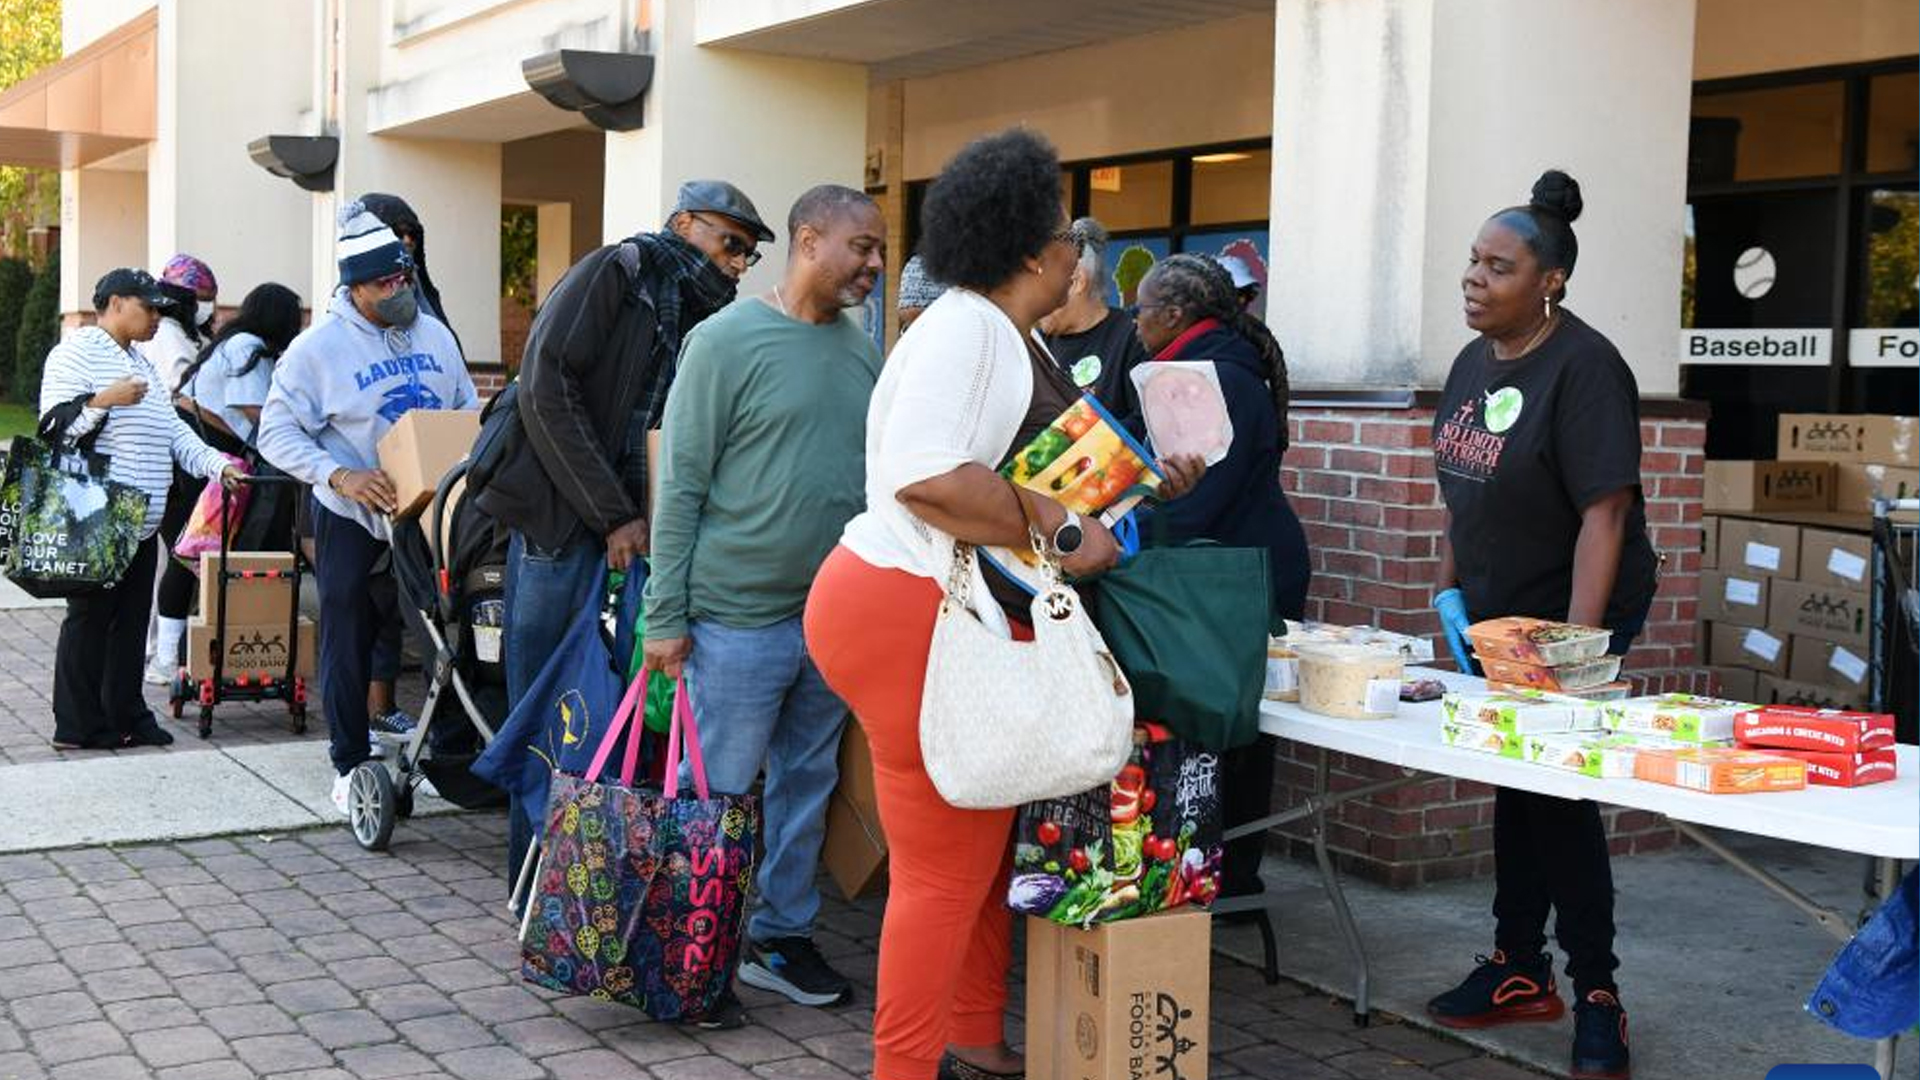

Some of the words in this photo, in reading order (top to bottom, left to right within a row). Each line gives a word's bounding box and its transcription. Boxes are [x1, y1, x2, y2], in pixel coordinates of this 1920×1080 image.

[1689, 335, 1816, 357] Baseball
[1878, 335, 1919, 358] Fo
[354, 353, 444, 391] LAUREL
[1436, 437, 1501, 467] OUTREACH
[25, 532, 68, 547] LOVE
[25, 546, 58, 559] OUR
[23, 560, 88, 574] PLANET
[1130, 993, 1144, 1049] FOOD
